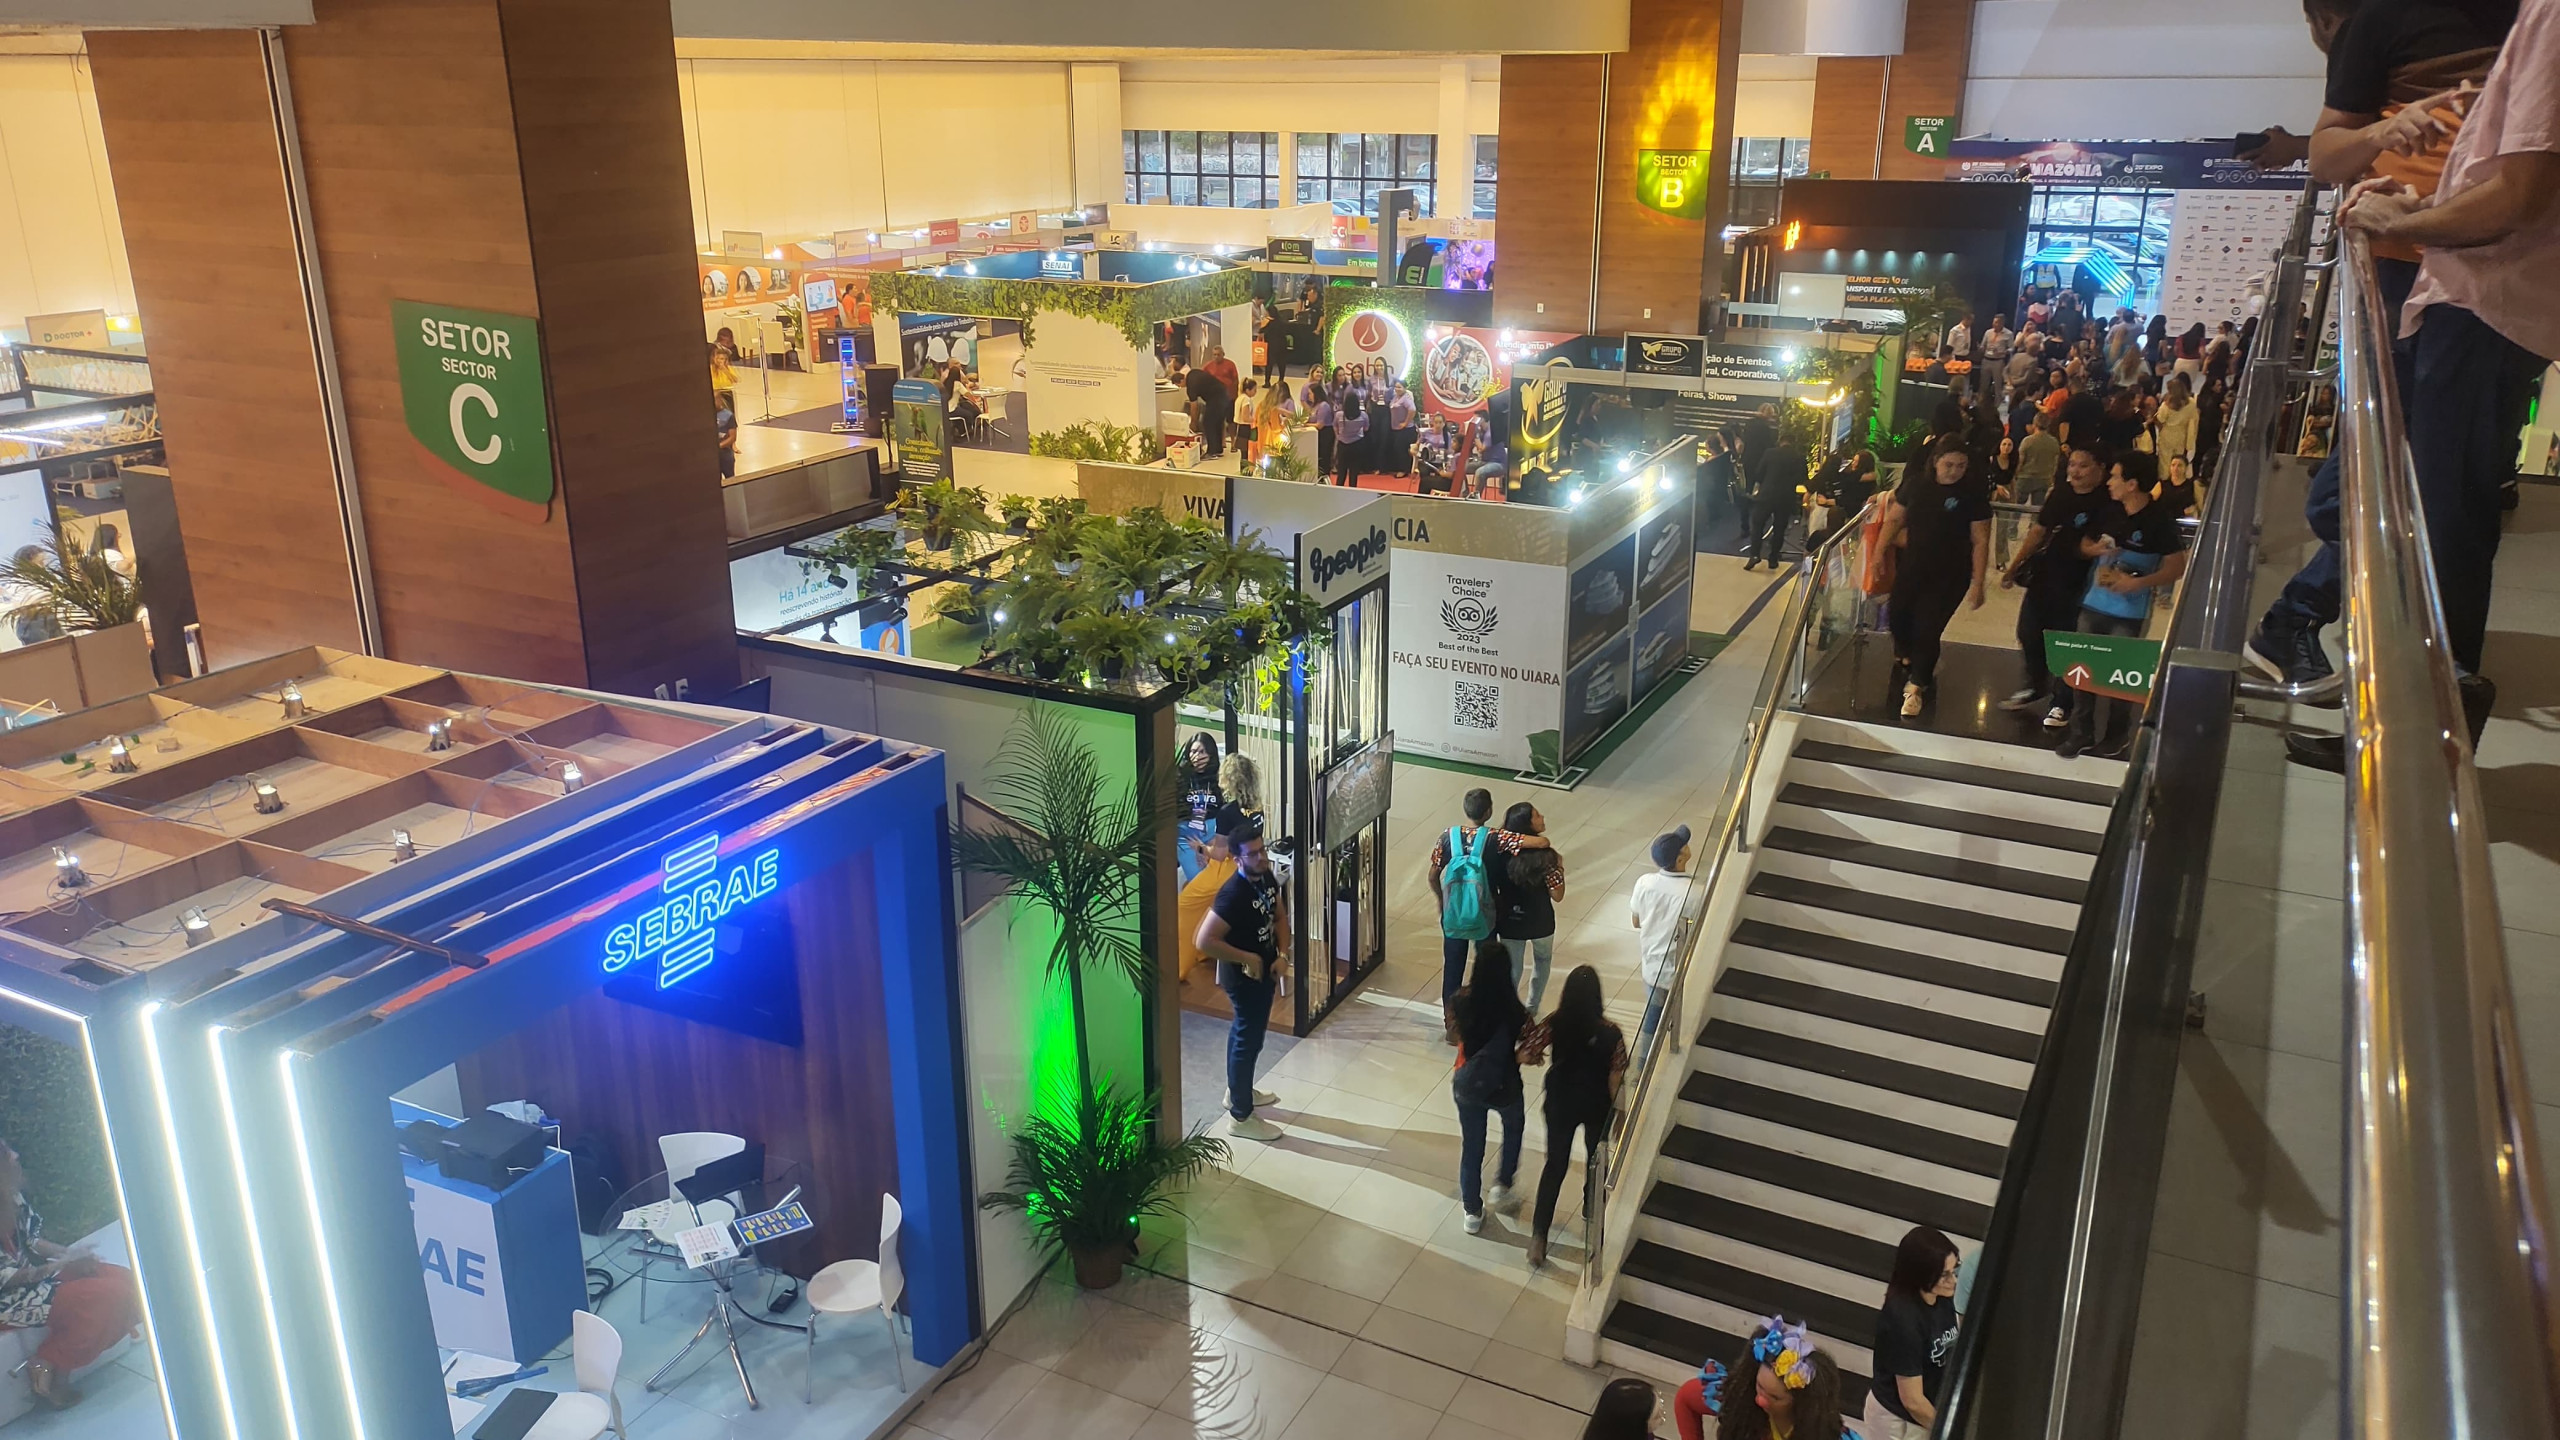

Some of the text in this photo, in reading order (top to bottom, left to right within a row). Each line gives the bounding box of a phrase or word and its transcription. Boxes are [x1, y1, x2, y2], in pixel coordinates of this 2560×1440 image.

[1914, 117, 1945, 126] SETOR
[1916, 132, 1935, 153] A
[1653, 154, 1698, 168] SETOR
[2029, 160, 2103, 177] MAZÔNIA
[1660, 168, 1688, 176] SECTOR
[1660, 177, 1684, 208] B
[1044, 261, 1070, 271] SENAI
[1358, 257, 1378, 267] breve
[54, 330, 85, 341] DOCTOR
[421, 317, 512, 360] SETOR
[1661, 345, 1682, 354] GRUPO
[1706, 354, 1773, 367] ção de Eventos
[441, 356, 497, 381] SECTOR
[1721, 368, 1781, 381] Corporativos,
[1678, 389, 1738, 402] Feiras, Shows
[450, 382, 502, 465] C
[1183, 495, 1226, 520] VIVA
[1393, 518, 1430, 543] CIA
[1446, 574, 1493, 589] Travelers'
[779, 588, 794, 604] Há
[797, 583, 807, 596] 14
[819, 589, 844, 603] histórias
[1451, 585, 1487, 598] Choice
[1456, 633, 1481, 644] 2023
[1438, 642, 1499, 657] Best of the Best
[1392, 651, 1561, 686] FAÇA SEU EVENTO NO UIARA
[2108, 668, 2143, 687] AO
[602, 848, 779, 972] SEBRAE
[420, 1237, 486, 1297] AE
